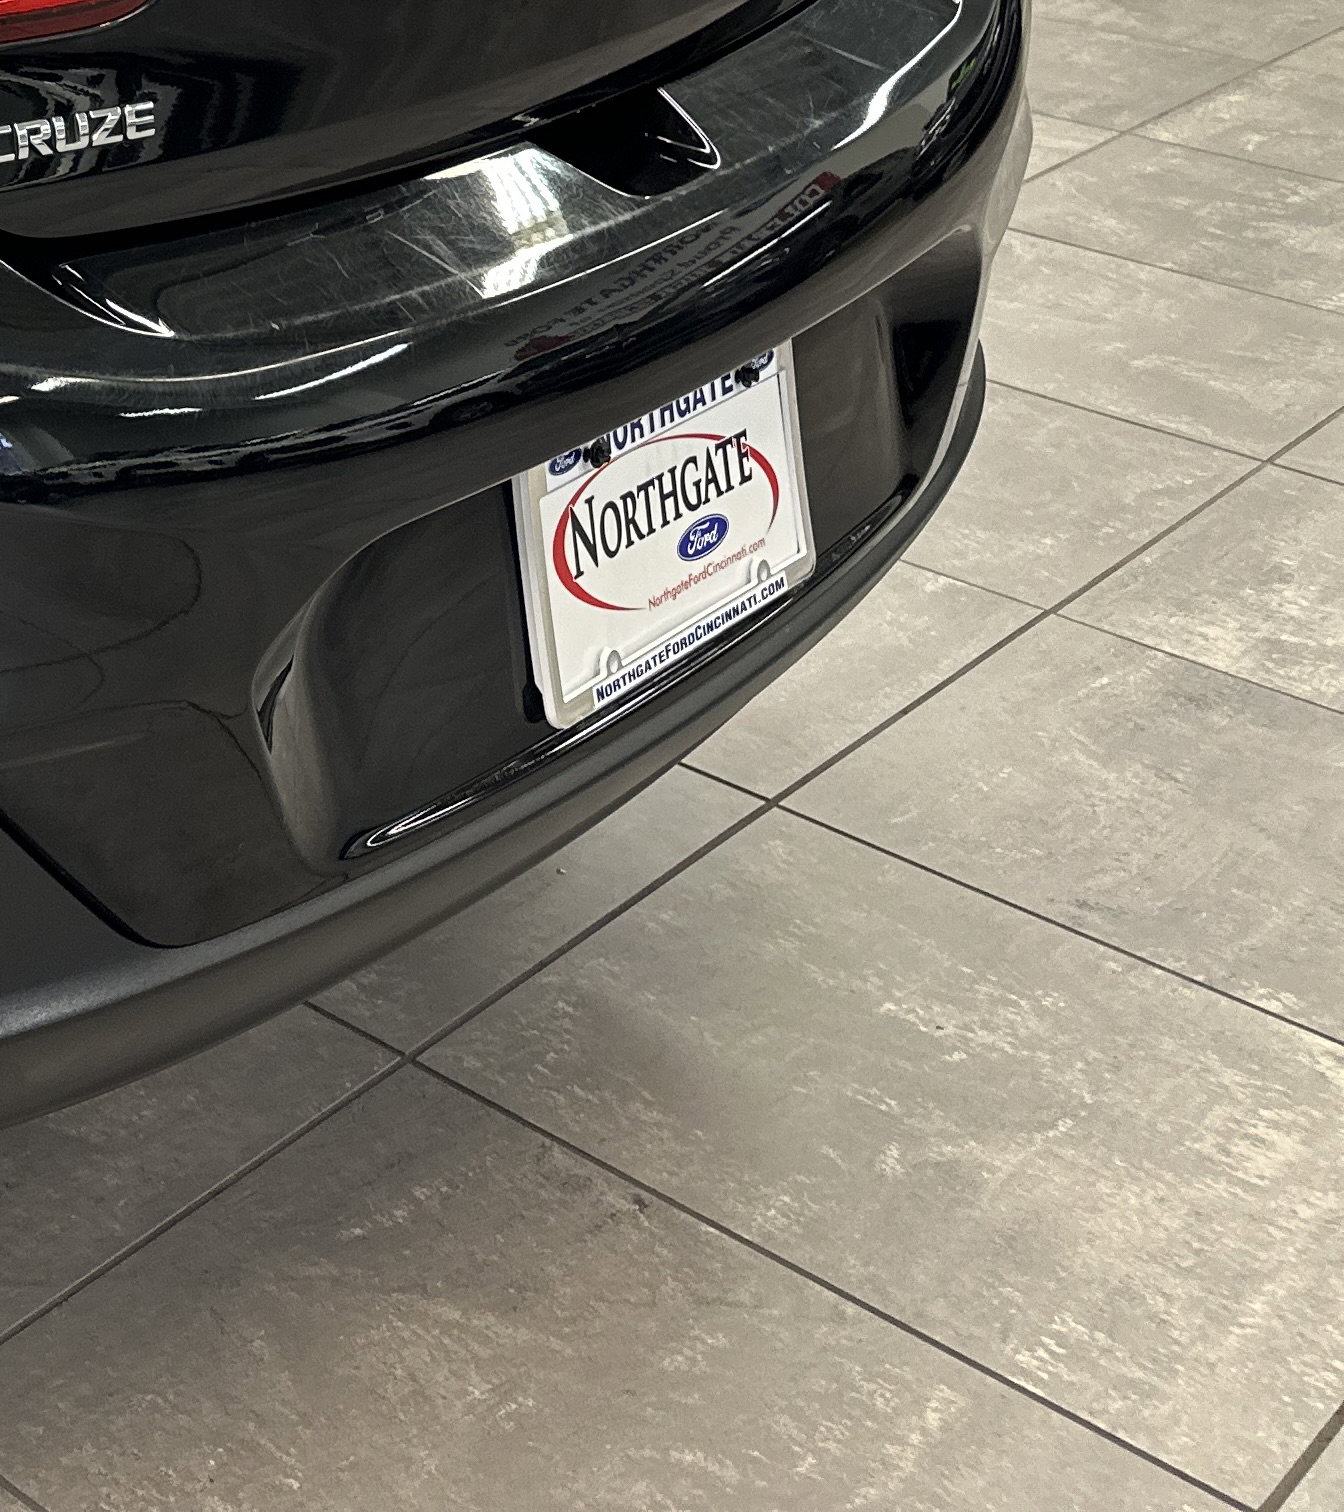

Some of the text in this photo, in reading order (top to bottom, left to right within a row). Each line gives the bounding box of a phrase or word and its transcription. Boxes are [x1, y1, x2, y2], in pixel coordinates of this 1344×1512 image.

[569, 428, 753, 580] NORTHGATE
[687, 521, 719, 555] Ford
[648, 538, 766, 612] NorthgateFordCincinnati.com
